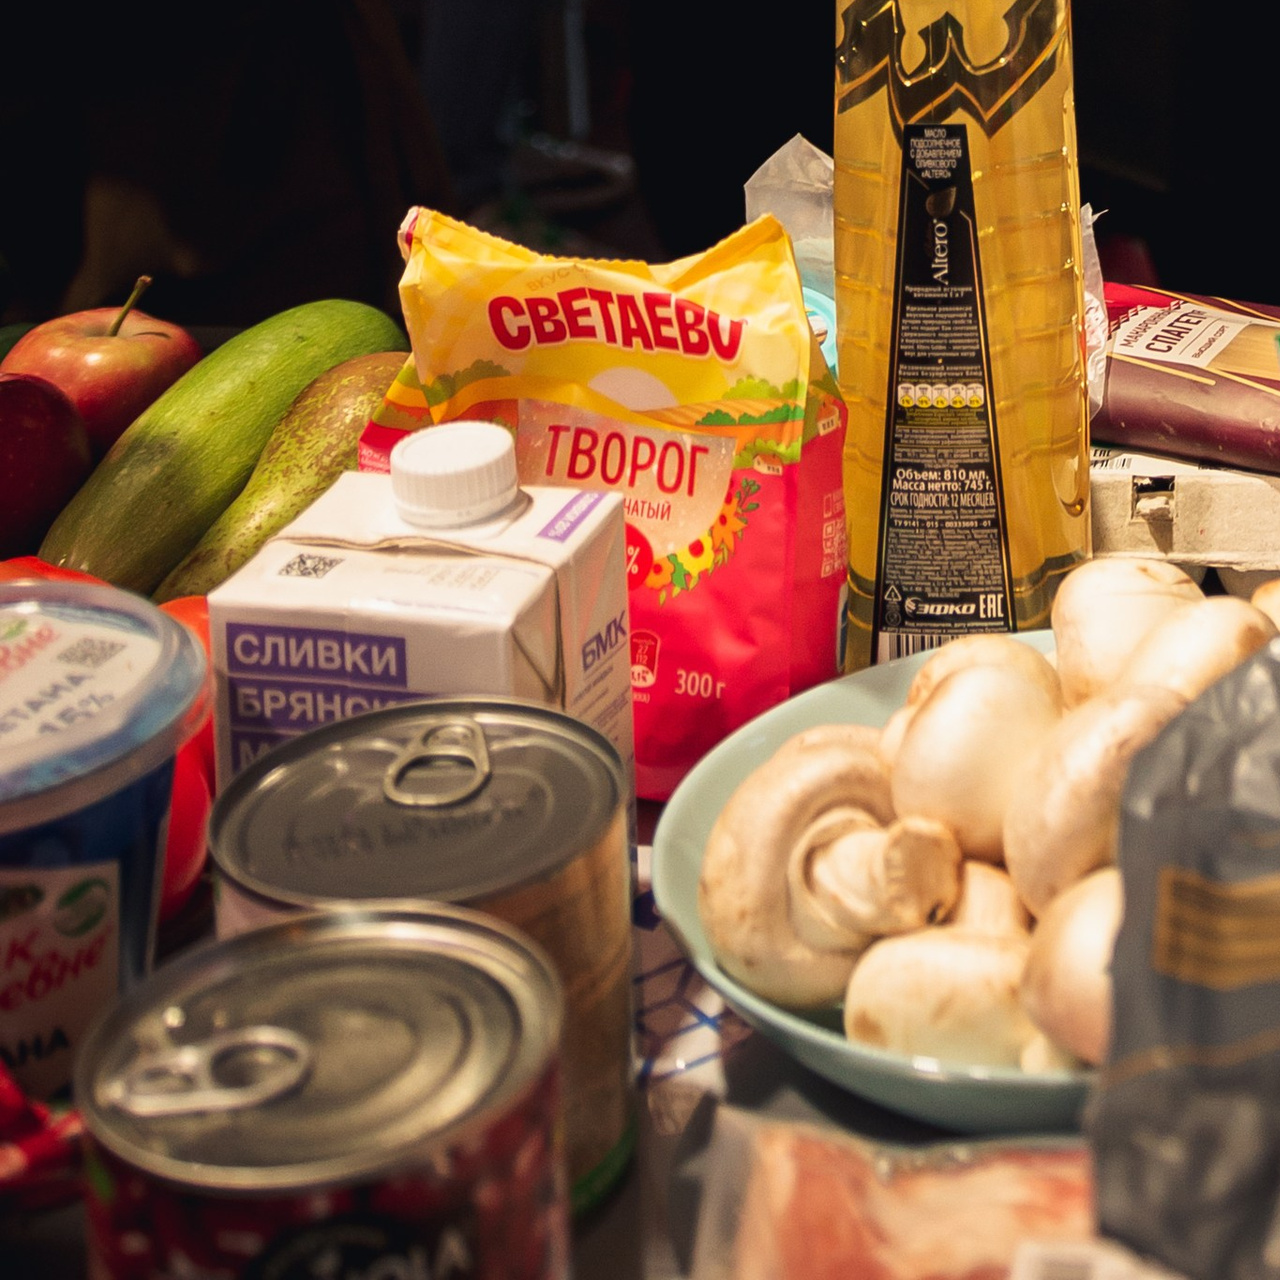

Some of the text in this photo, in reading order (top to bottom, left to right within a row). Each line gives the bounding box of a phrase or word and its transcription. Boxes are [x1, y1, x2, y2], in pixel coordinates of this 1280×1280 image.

[924, 128, 947, 139] МАСЛО
[931, 221, 949, 286] Altero
[544, 424, 710, 498] ТВОРОГ
[896, 468, 942, 480] Объем:
[944, 468, 966, 480] 810
[892, 478, 926, 491] Масса
[927, 481, 962, 491] нетто:
[964, 480, 983, 491] 745
[623, 497, 672, 522] ЧАТЫЙ
[890, 492, 909, 506] СРОК
[234, 633, 397, 677] СЛИВКИ
[582, 610, 627, 674] БМК
[674, 669, 710, 699] 300
[714, 676, 726, 700] г
